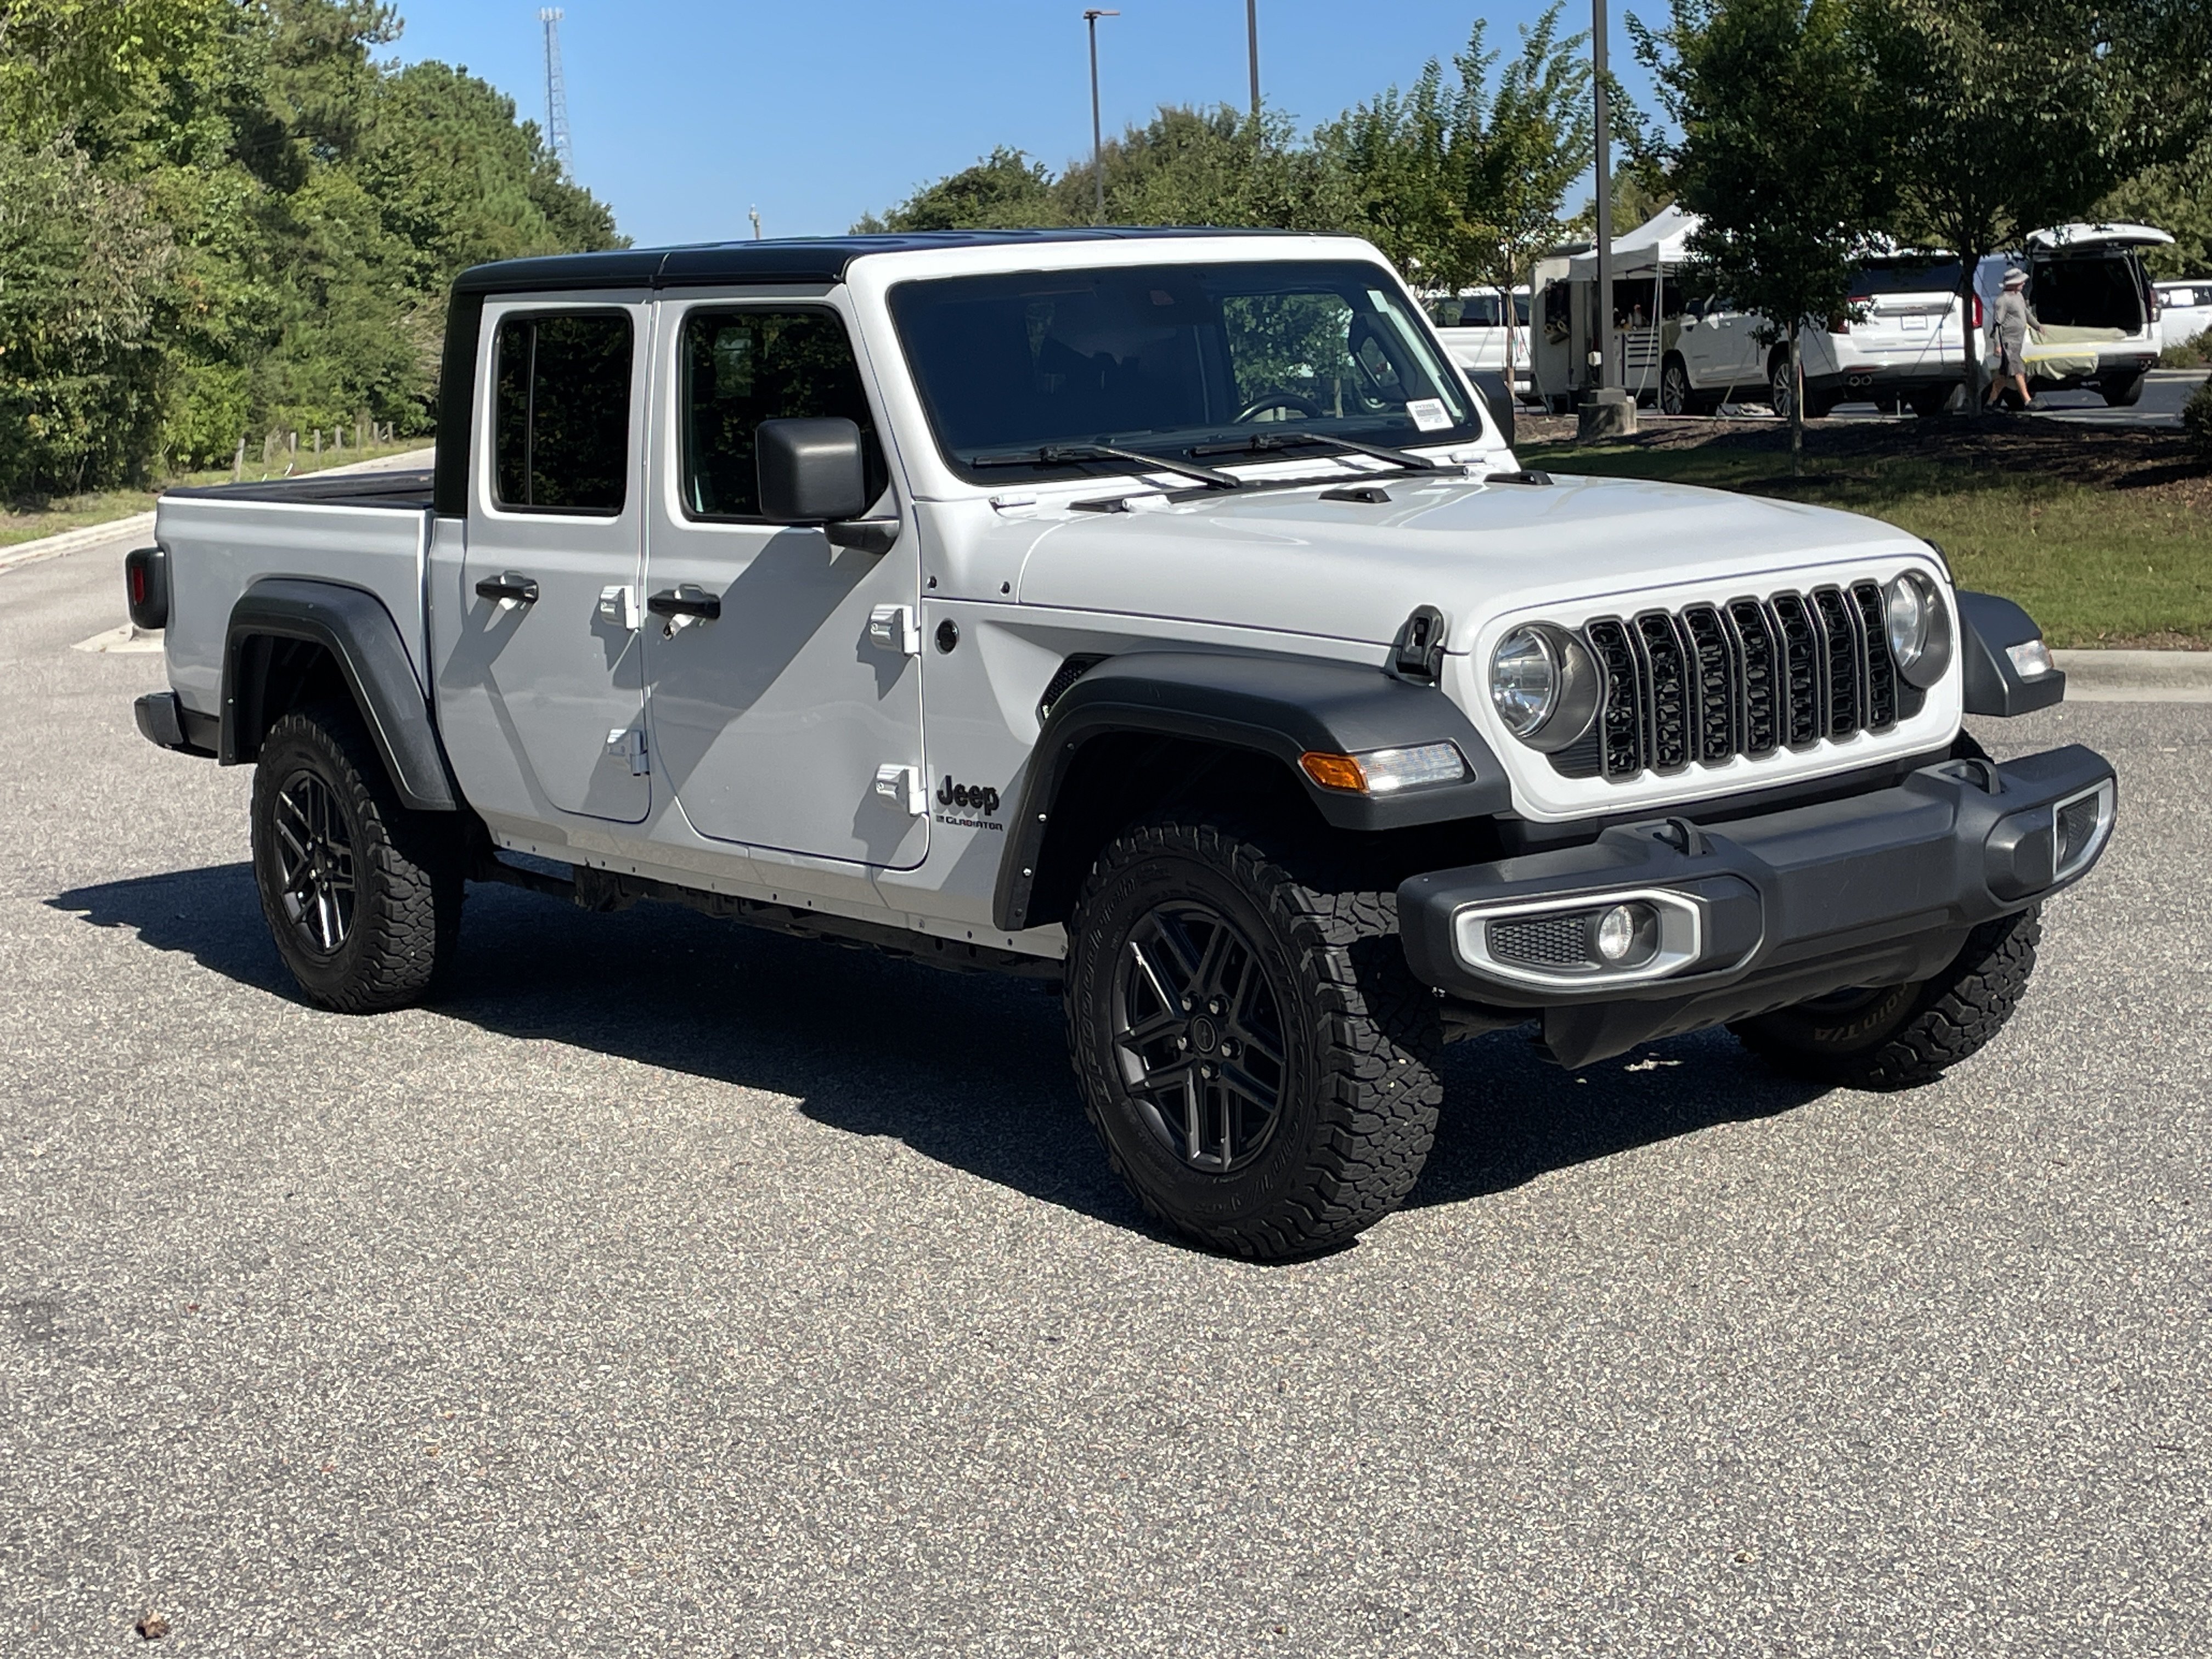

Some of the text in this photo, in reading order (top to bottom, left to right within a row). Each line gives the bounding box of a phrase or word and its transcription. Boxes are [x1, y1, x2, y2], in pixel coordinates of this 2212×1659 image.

[936, 775, 1000, 816] Jeep
[945, 815, 1004, 832] GLADIATOR
[1814, 1024, 1859, 1042] T/A
